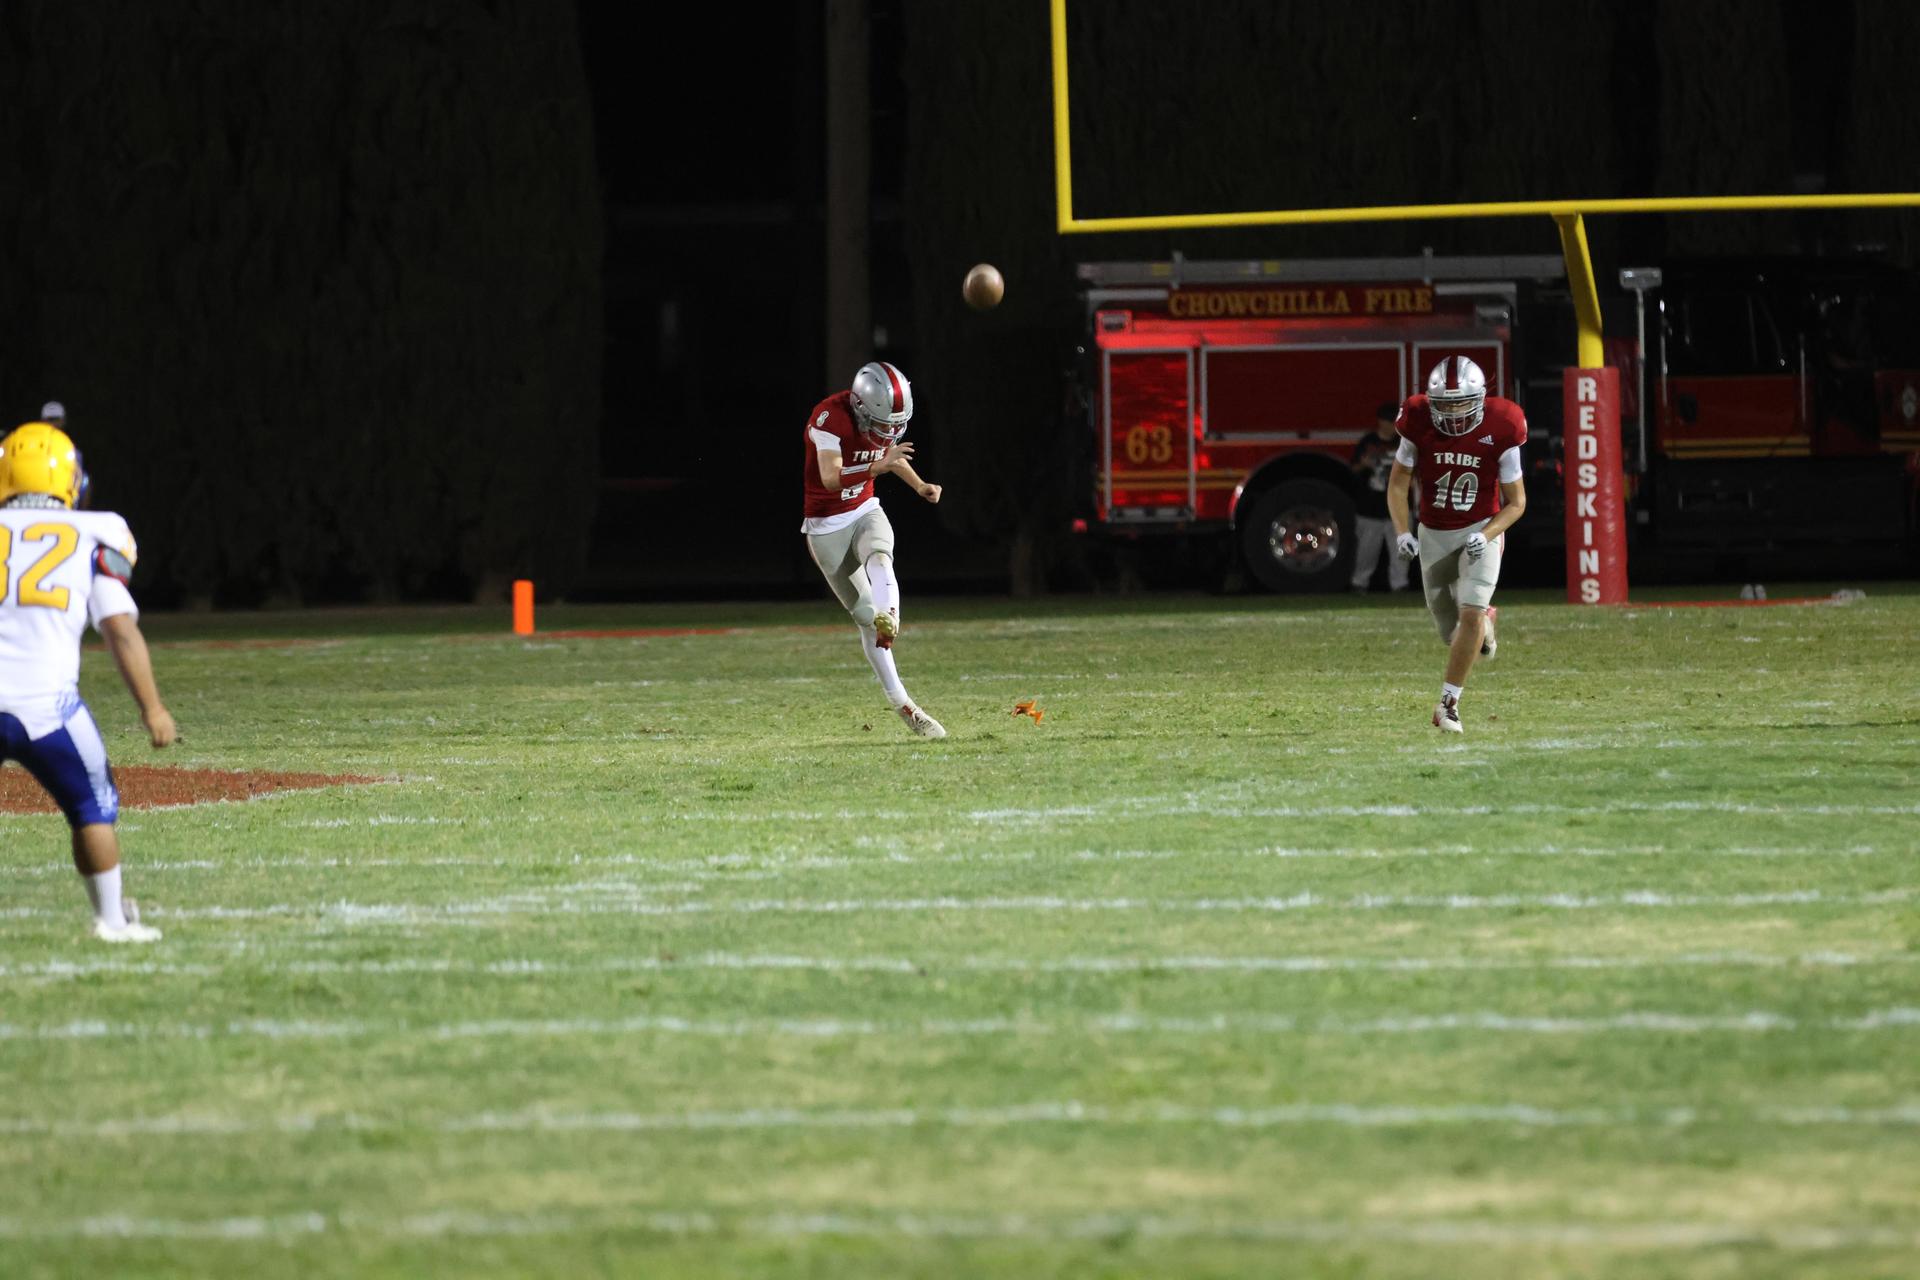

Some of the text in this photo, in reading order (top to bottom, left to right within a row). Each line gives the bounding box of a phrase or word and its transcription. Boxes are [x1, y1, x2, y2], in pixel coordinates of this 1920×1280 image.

[1169, 287, 1433, 317] CHOWCHILLA FIRE
[816, 410, 829, 427] 8
[1126, 425, 1174, 464] 63
[1433, 452, 1481, 469] TRIBE
[1432, 470, 1479, 512] 10
[1577, 376, 1601, 603] REDSKINS
[0, 522, 80, 612] 2
